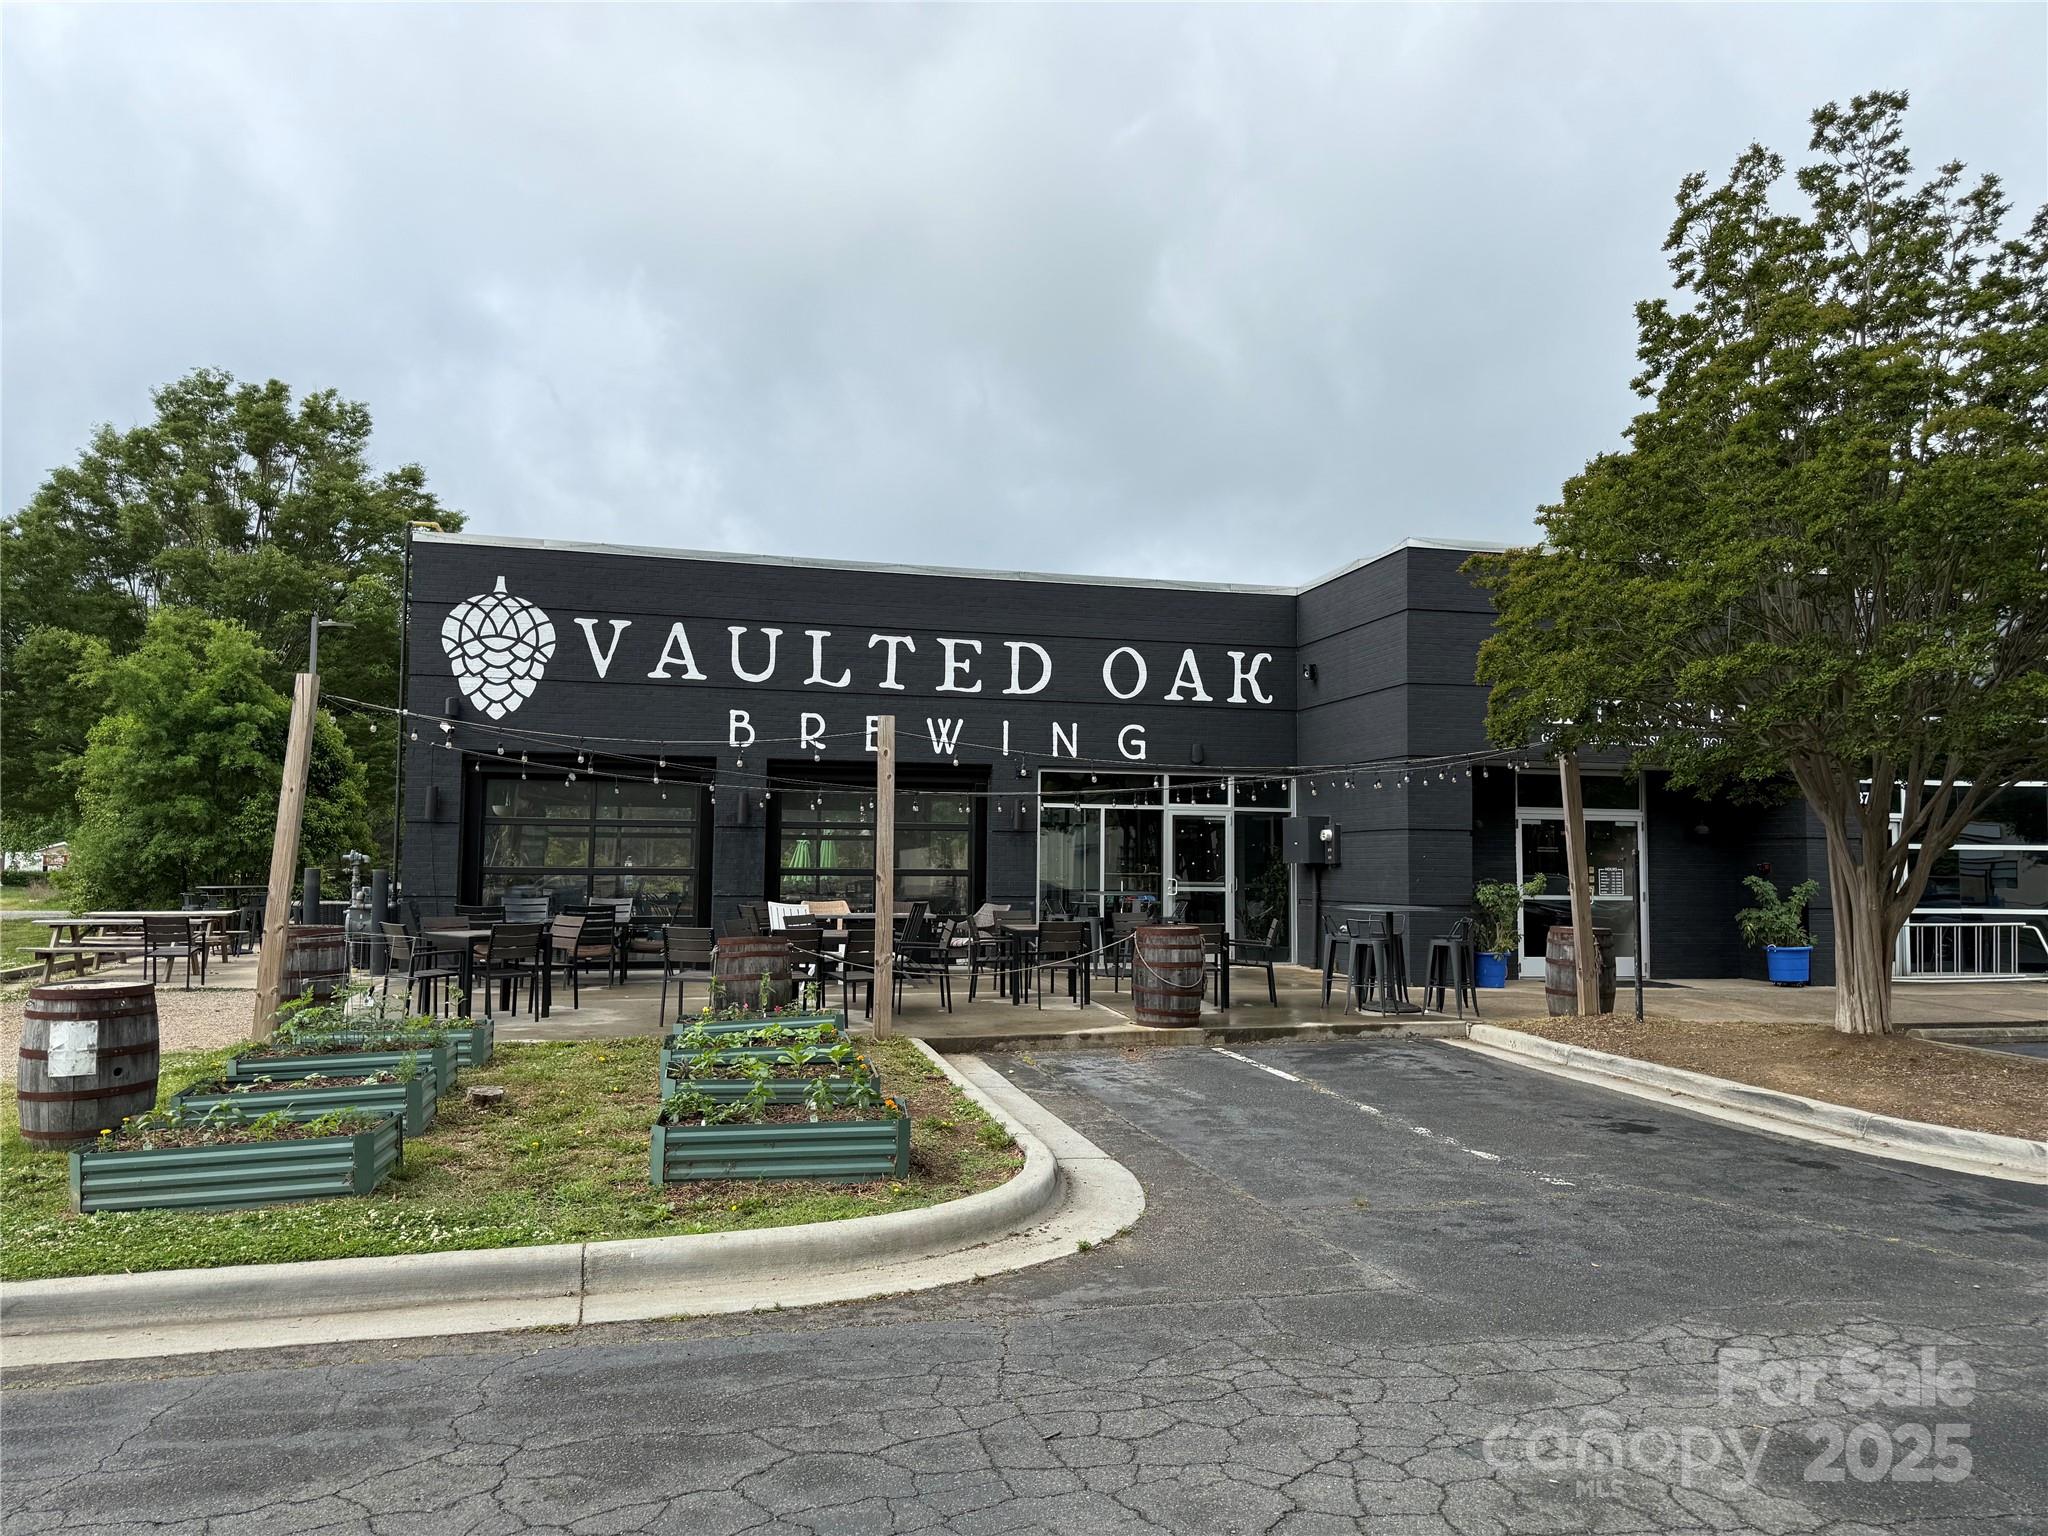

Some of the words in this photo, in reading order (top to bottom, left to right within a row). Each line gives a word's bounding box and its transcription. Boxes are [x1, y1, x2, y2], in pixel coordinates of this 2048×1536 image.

[573, 617, 1053, 695] VAULTED
[1102, 646, 1273, 704] OAK
[729, 709, 1148, 761] BREWING
